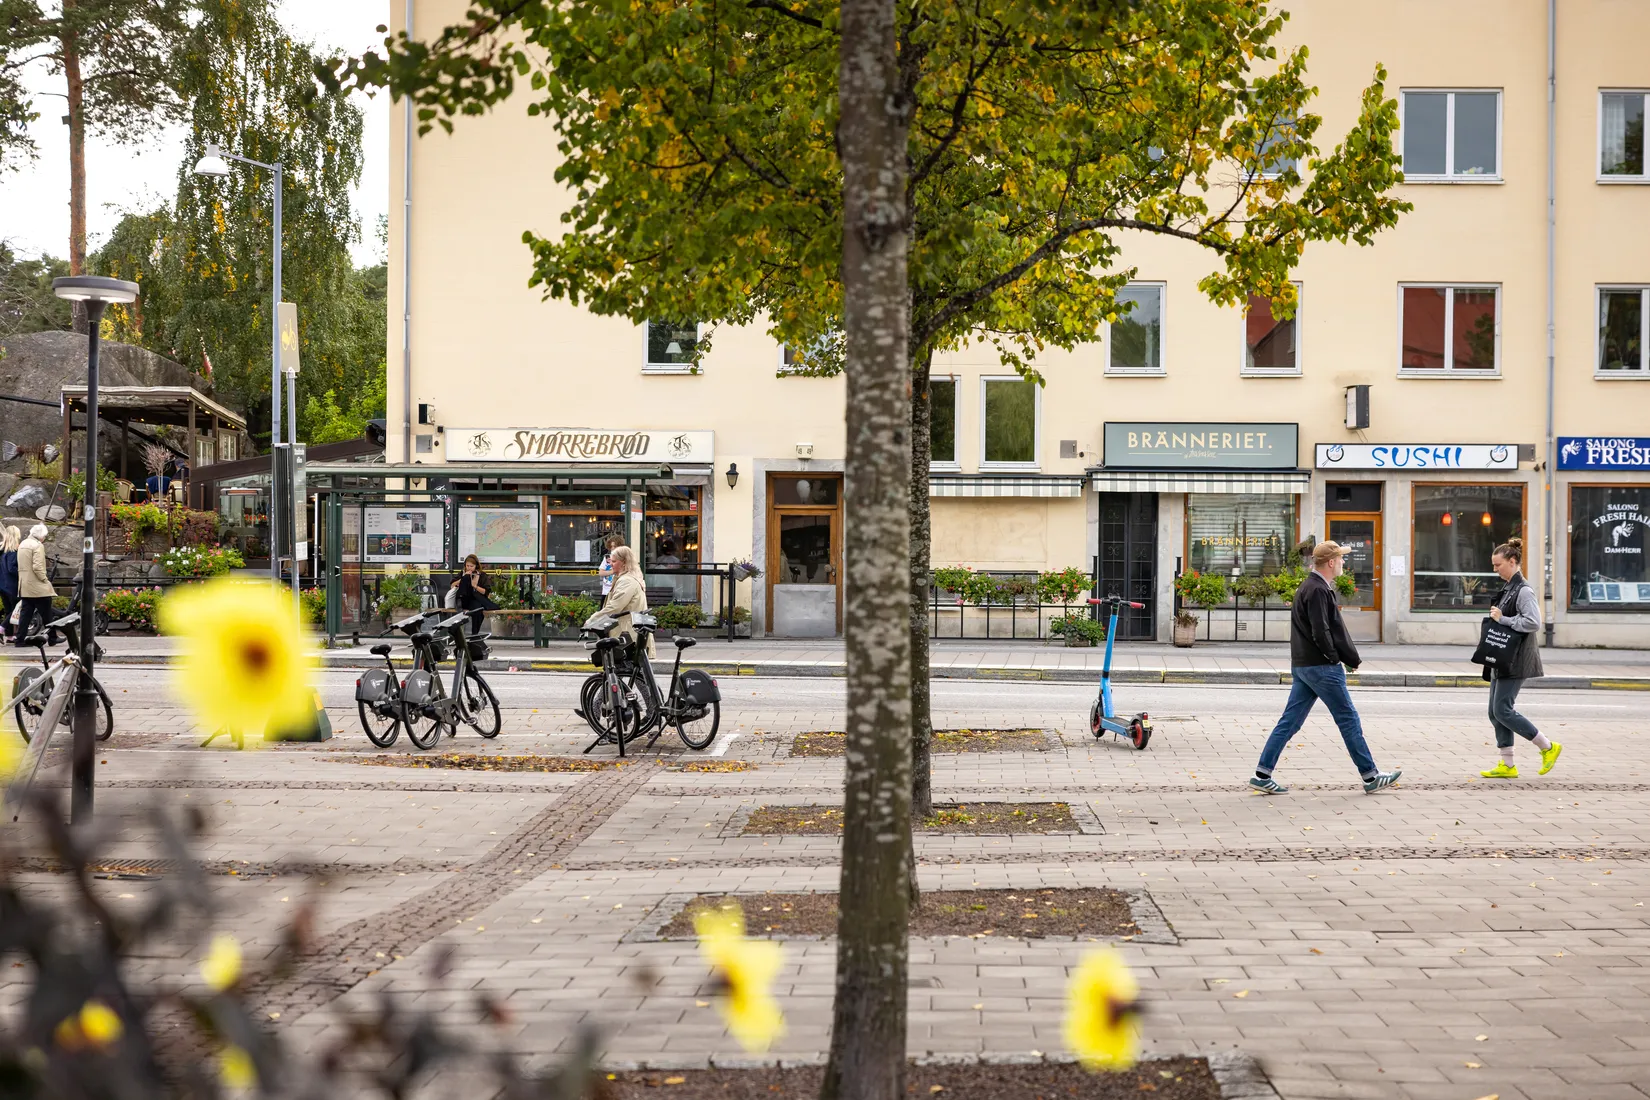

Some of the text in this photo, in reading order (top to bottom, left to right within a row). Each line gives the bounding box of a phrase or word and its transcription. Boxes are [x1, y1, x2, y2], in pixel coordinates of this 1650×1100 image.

[504, 431, 650, 459] SMØRREBRØD
[1128, 431, 1273, 449] BRÄNNERIET.
[1586, 438, 1636, 449] SALONG
[1371, 447, 1463, 467] SUSHI
[1592, 512, 1627, 528] FRESH
[1487, 634, 1509, 643] universal
[1488, 628, 1502, 636] Music
[1485, 637, 1507, 648] language
